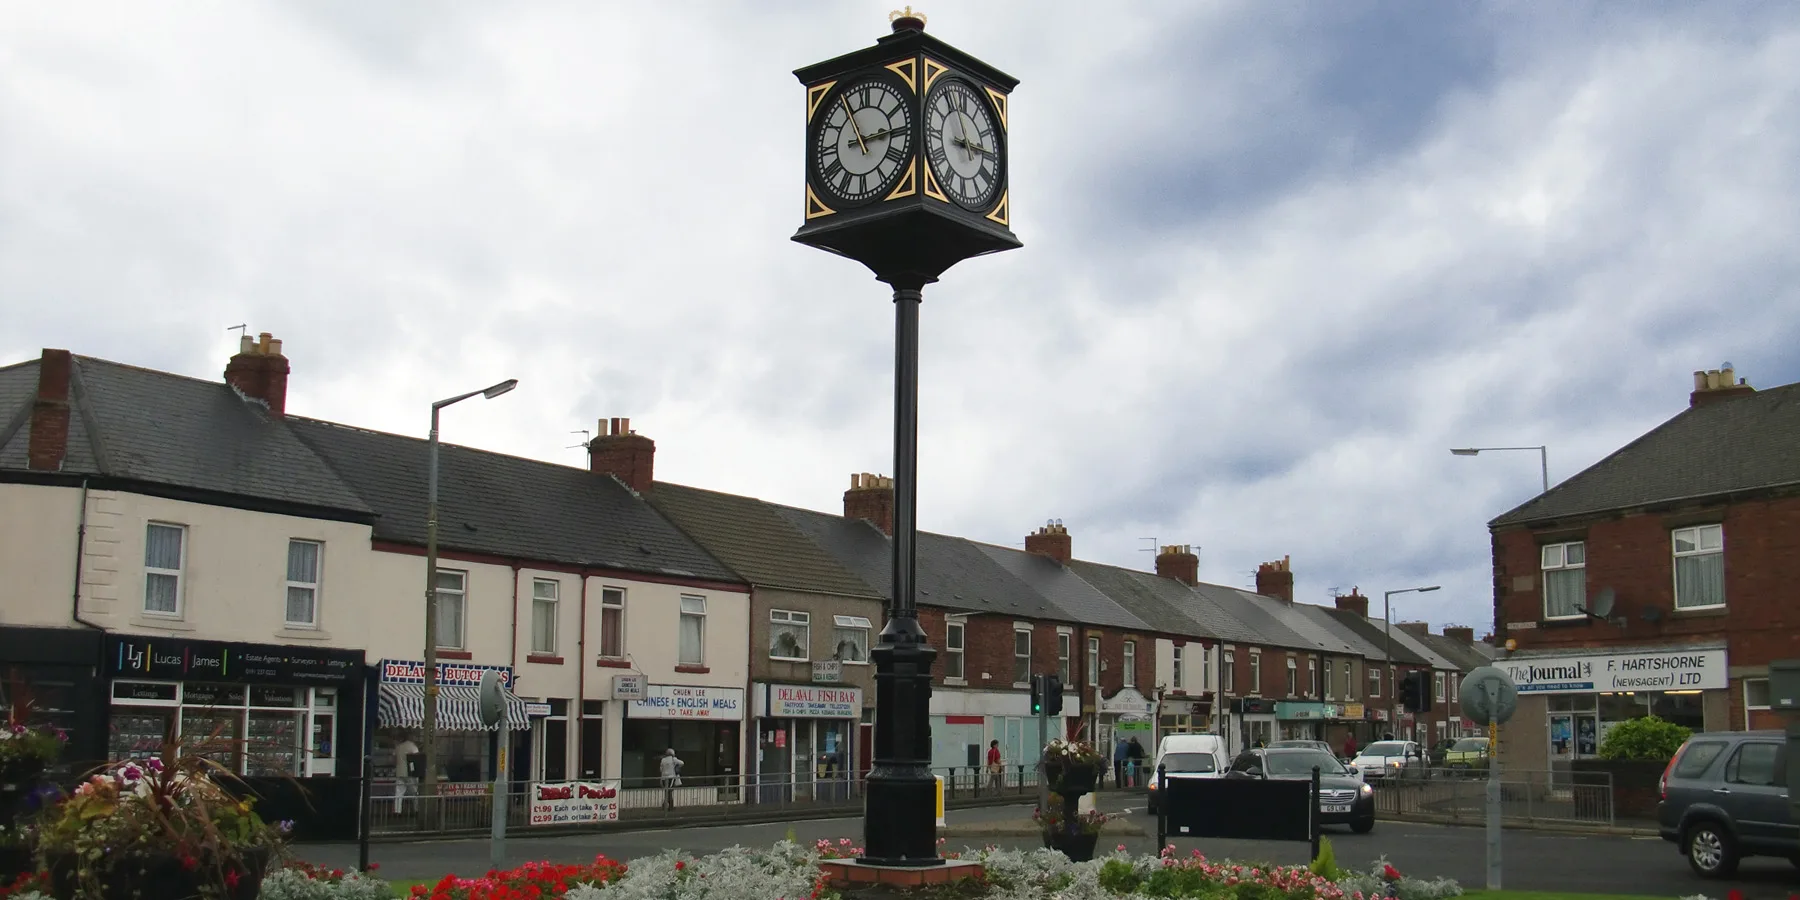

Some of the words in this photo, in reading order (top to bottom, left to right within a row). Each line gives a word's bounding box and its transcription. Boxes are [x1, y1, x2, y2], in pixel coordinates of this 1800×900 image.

[127, 644, 143, 669] LJ
[154, 653, 181, 665] Lucas
[192, 655, 220, 668] James
[263, 655, 281, 664] Agents
[291, 656, 317, 666] Surveyors
[327, 660, 347, 668] Lettings
[813, 662, 823, 670] FISH
[827, 662, 838, 670] CHIPS
[1607, 660, 1617, 671] F.
[1621, 656, 1705, 671] HARTSHORNE
[387, 665, 441, 679] DELAVL
[1569, 682, 1584, 690] know
[1612, 672, 1674, 688] (NEWSAGENT)
[1679, 672, 1701, 685] LTD
[132, 689, 159, 698] Lettings
[184, 691, 214, 700] Mortgages
[263, 694, 292, 702] Valuations
[672, 688, 692, 697] CHUEN
[695, 689, 705, 697] LEE
[778, 688, 814, 701] DELAVAL
[817, 689, 837, 703] FISH
[839, 691, 856, 703] BAR
[637, 697, 670, 708] CHINESE
[677, 698, 708, 708] ENGLISH
[712, 698, 737, 710] MEALS
[668, 708, 677, 716] TO
[680, 708, 694, 717] TAKE
[696, 708, 710, 717] AWAY
[579, 785, 617, 799] Packs
[533, 805, 552, 813] £1.99
[554, 804, 569, 812] Each
[609, 801, 617, 809] £5
[533, 815, 552, 823] £2.99
[553, 814, 569, 822] Each
[609, 811, 617, 819] £5
